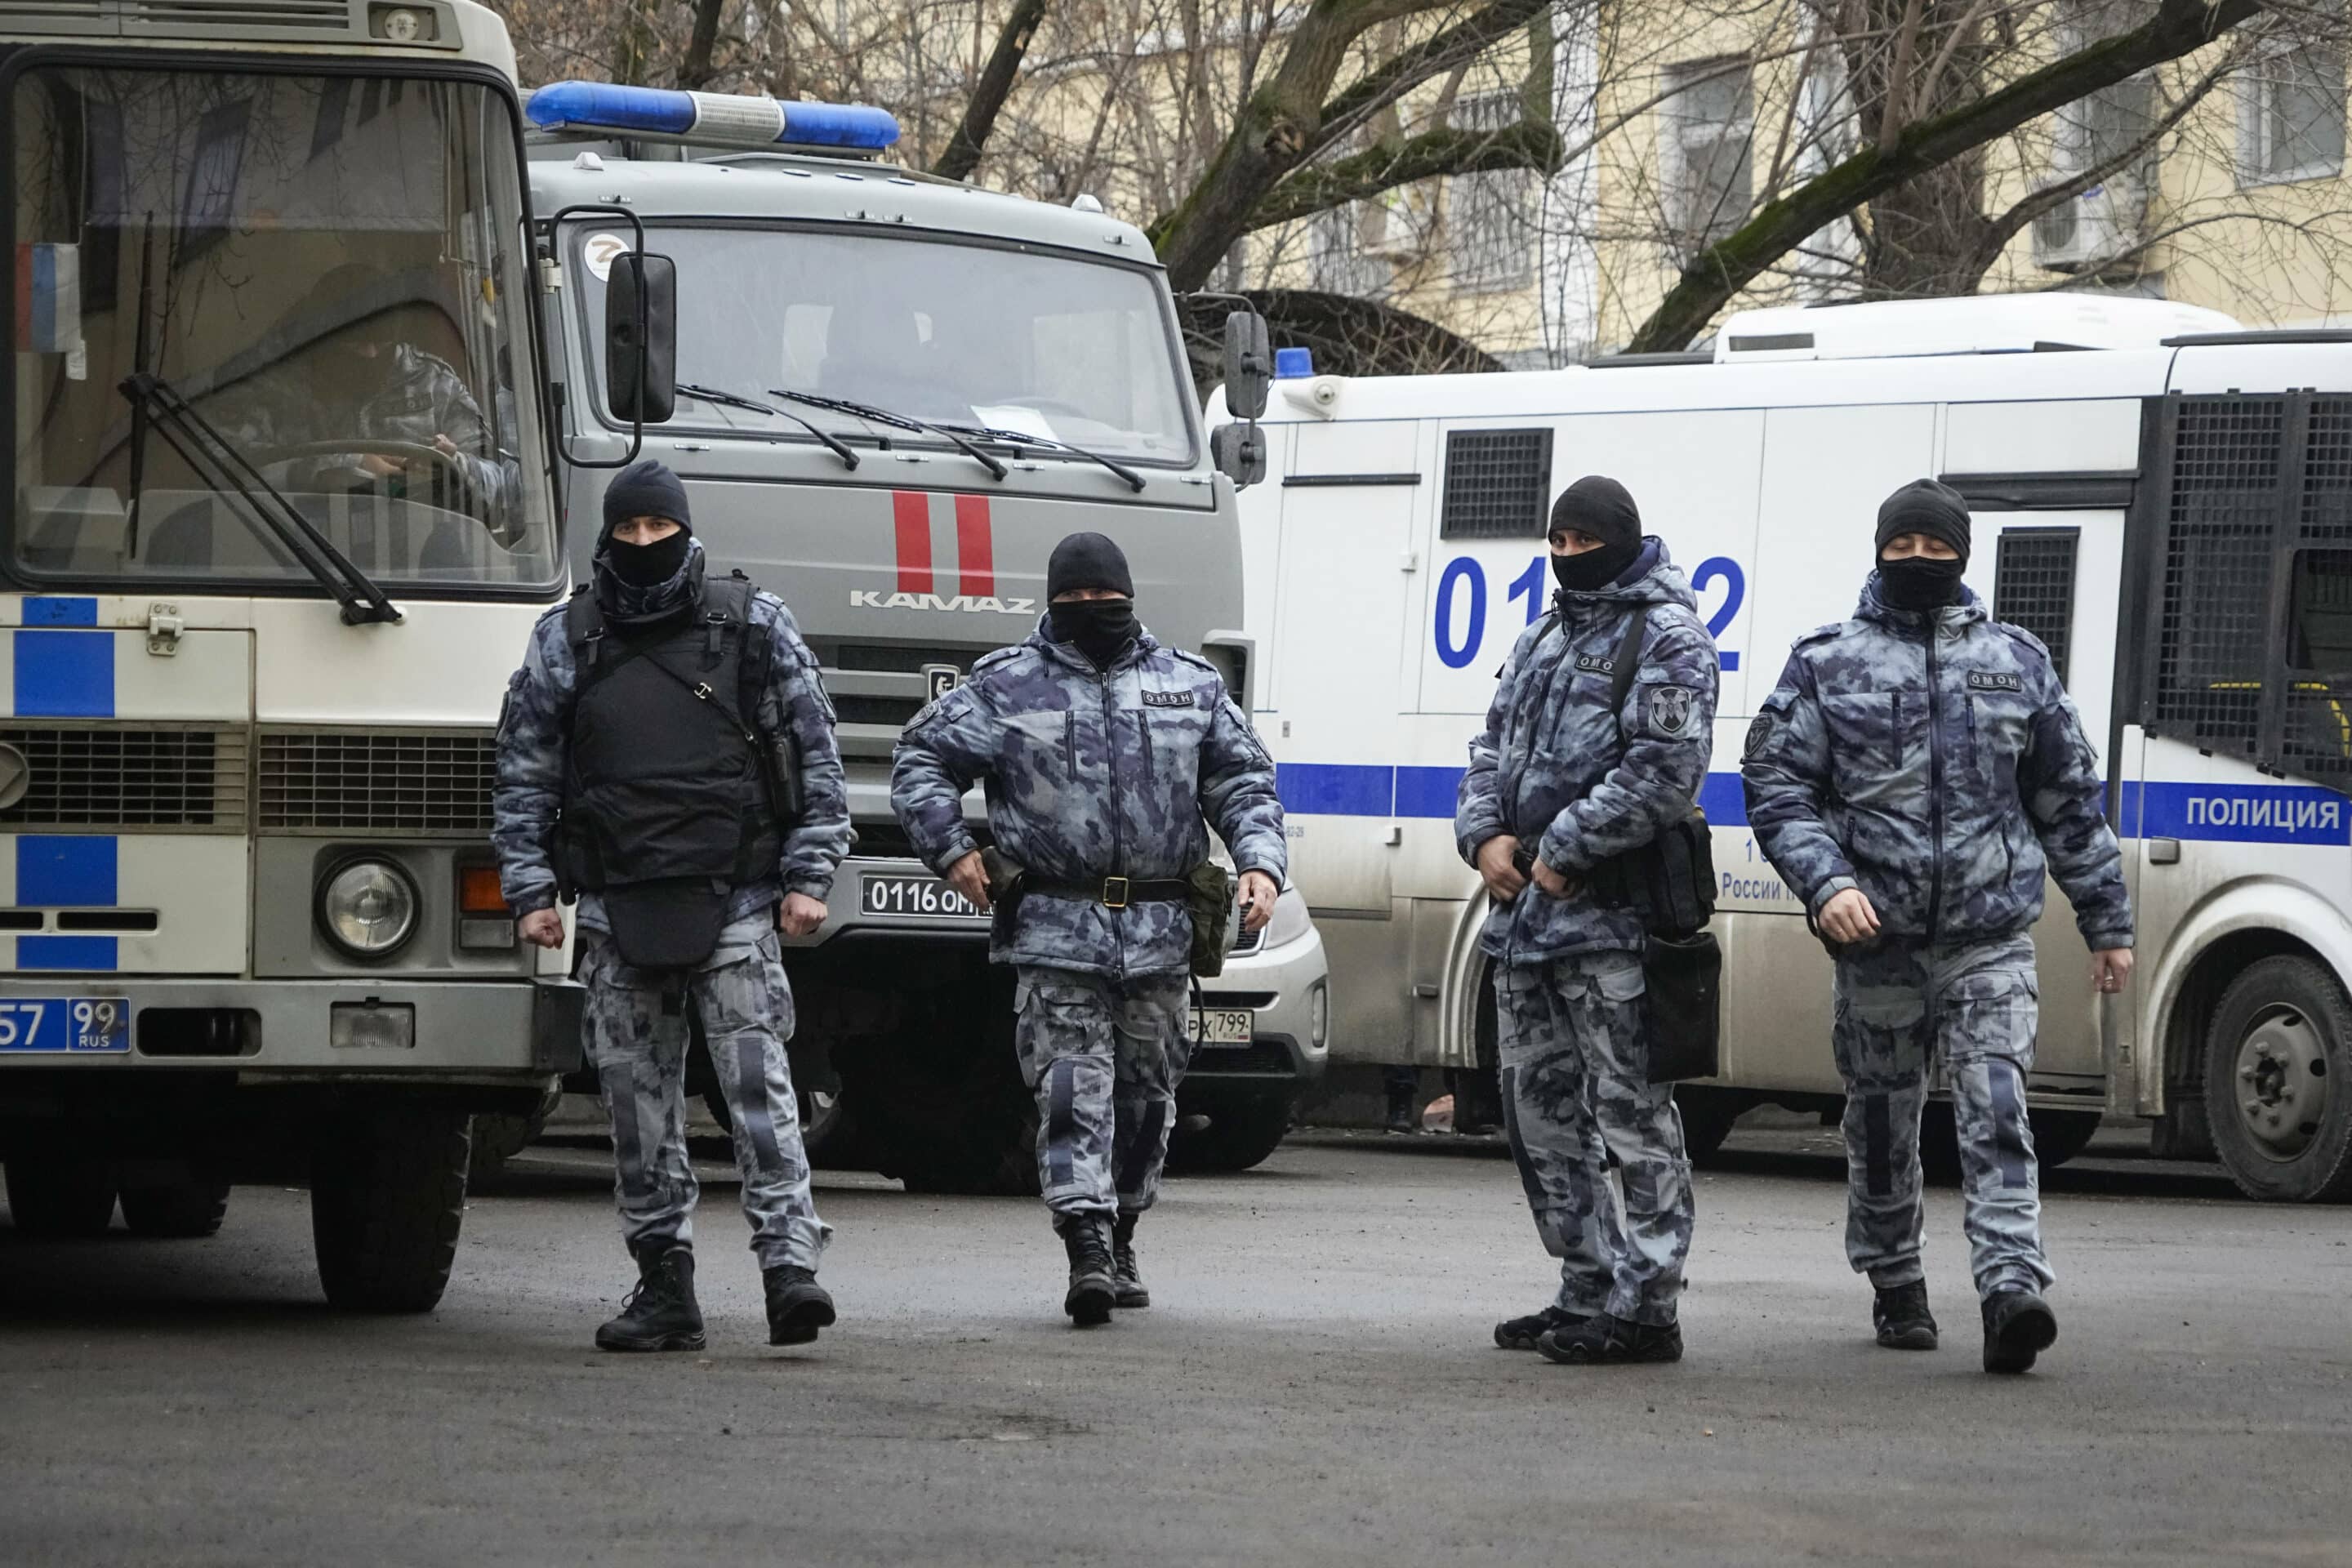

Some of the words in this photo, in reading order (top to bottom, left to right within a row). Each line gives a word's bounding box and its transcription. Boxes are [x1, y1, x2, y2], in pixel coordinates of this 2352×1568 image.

[850, 590, 1036, 614] KAMAZ
[1580, 657, 1613, 670] ОМО
[1971, 675, 2017, 687] ОМОН
[1146, 693, 1191, 703] ОМОН
[2187, 797, 2340, 833] ПОЛИЦИЯ
[1745, 838, 1753, 862] 1
[1722, 871, 1781, 900] России
[0, 1004, 44, 1045] 57
[74, 1001, 115, 1034] 99
[1218, 1013, 1247, 1032] 799
[78, 1036, 109, 1047] RUS
